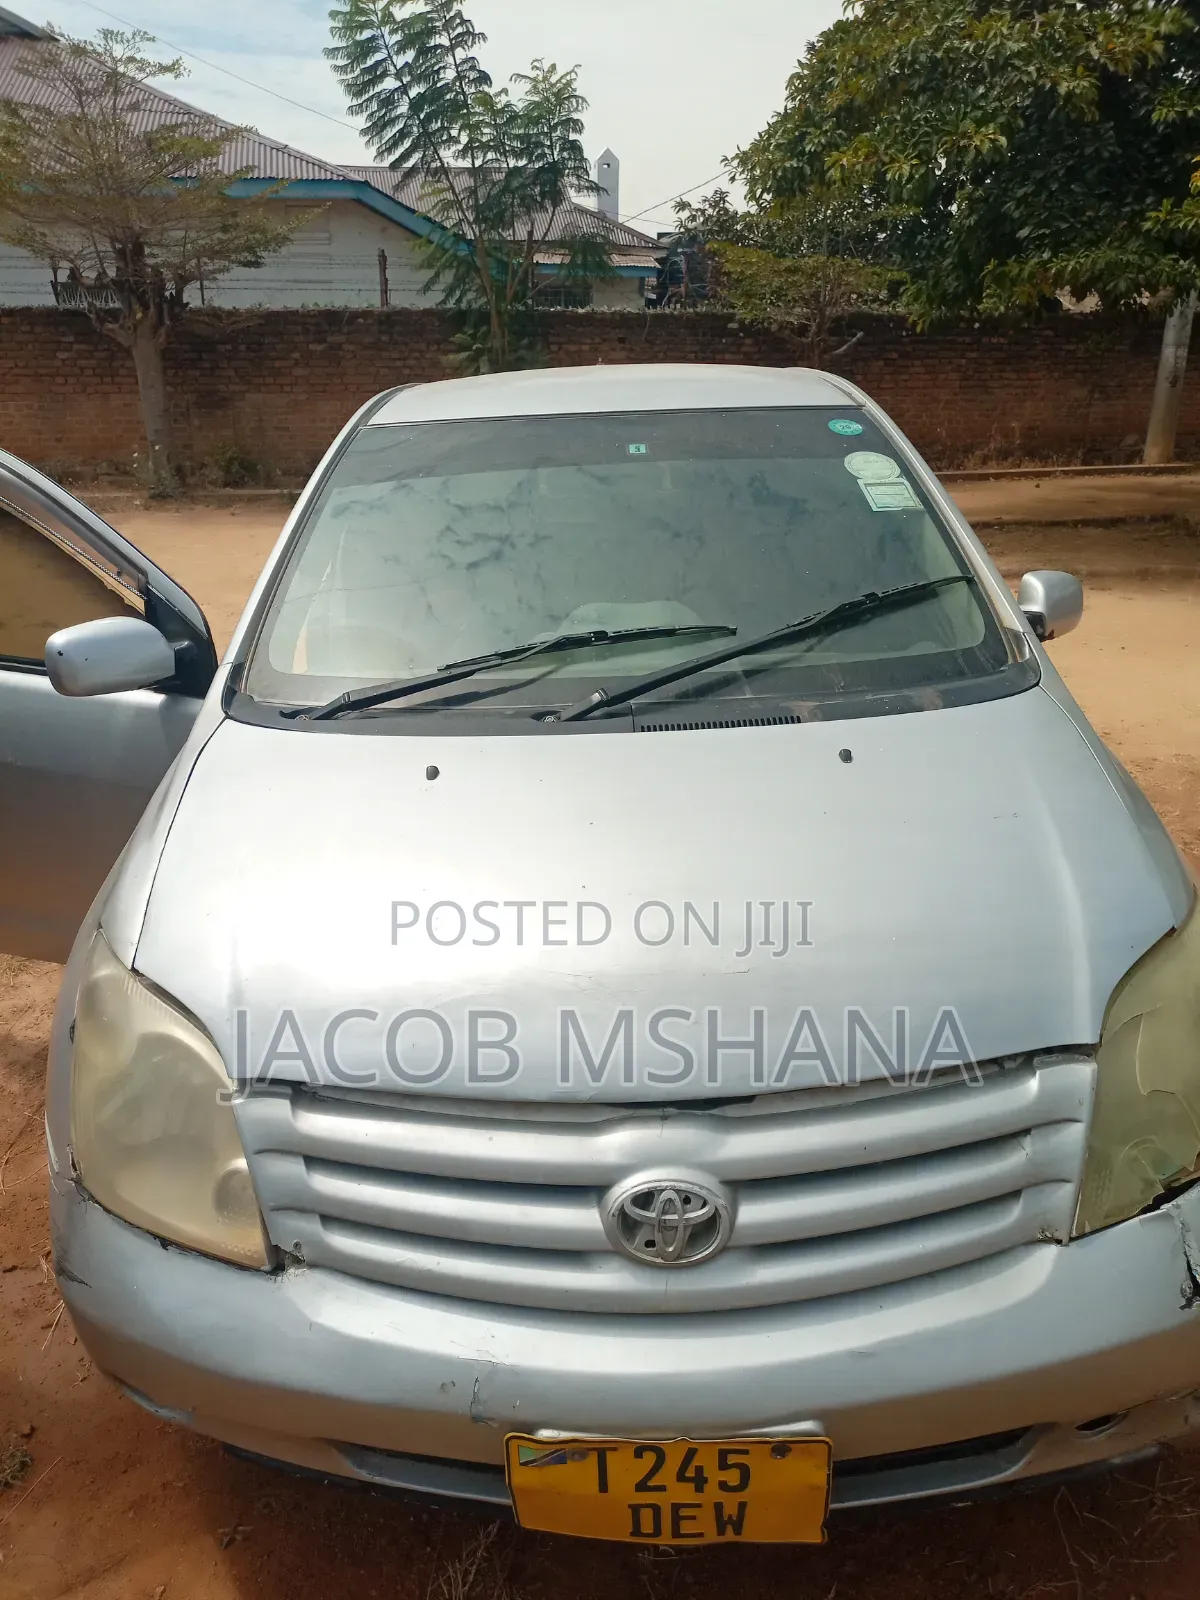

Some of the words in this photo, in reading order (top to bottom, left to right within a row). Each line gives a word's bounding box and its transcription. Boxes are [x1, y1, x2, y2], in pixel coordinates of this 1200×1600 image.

[587, 1446, 618, 1493] T
[633, 1445, 751, 1493] 245
[628, 1501, 748, 1538] DEW
